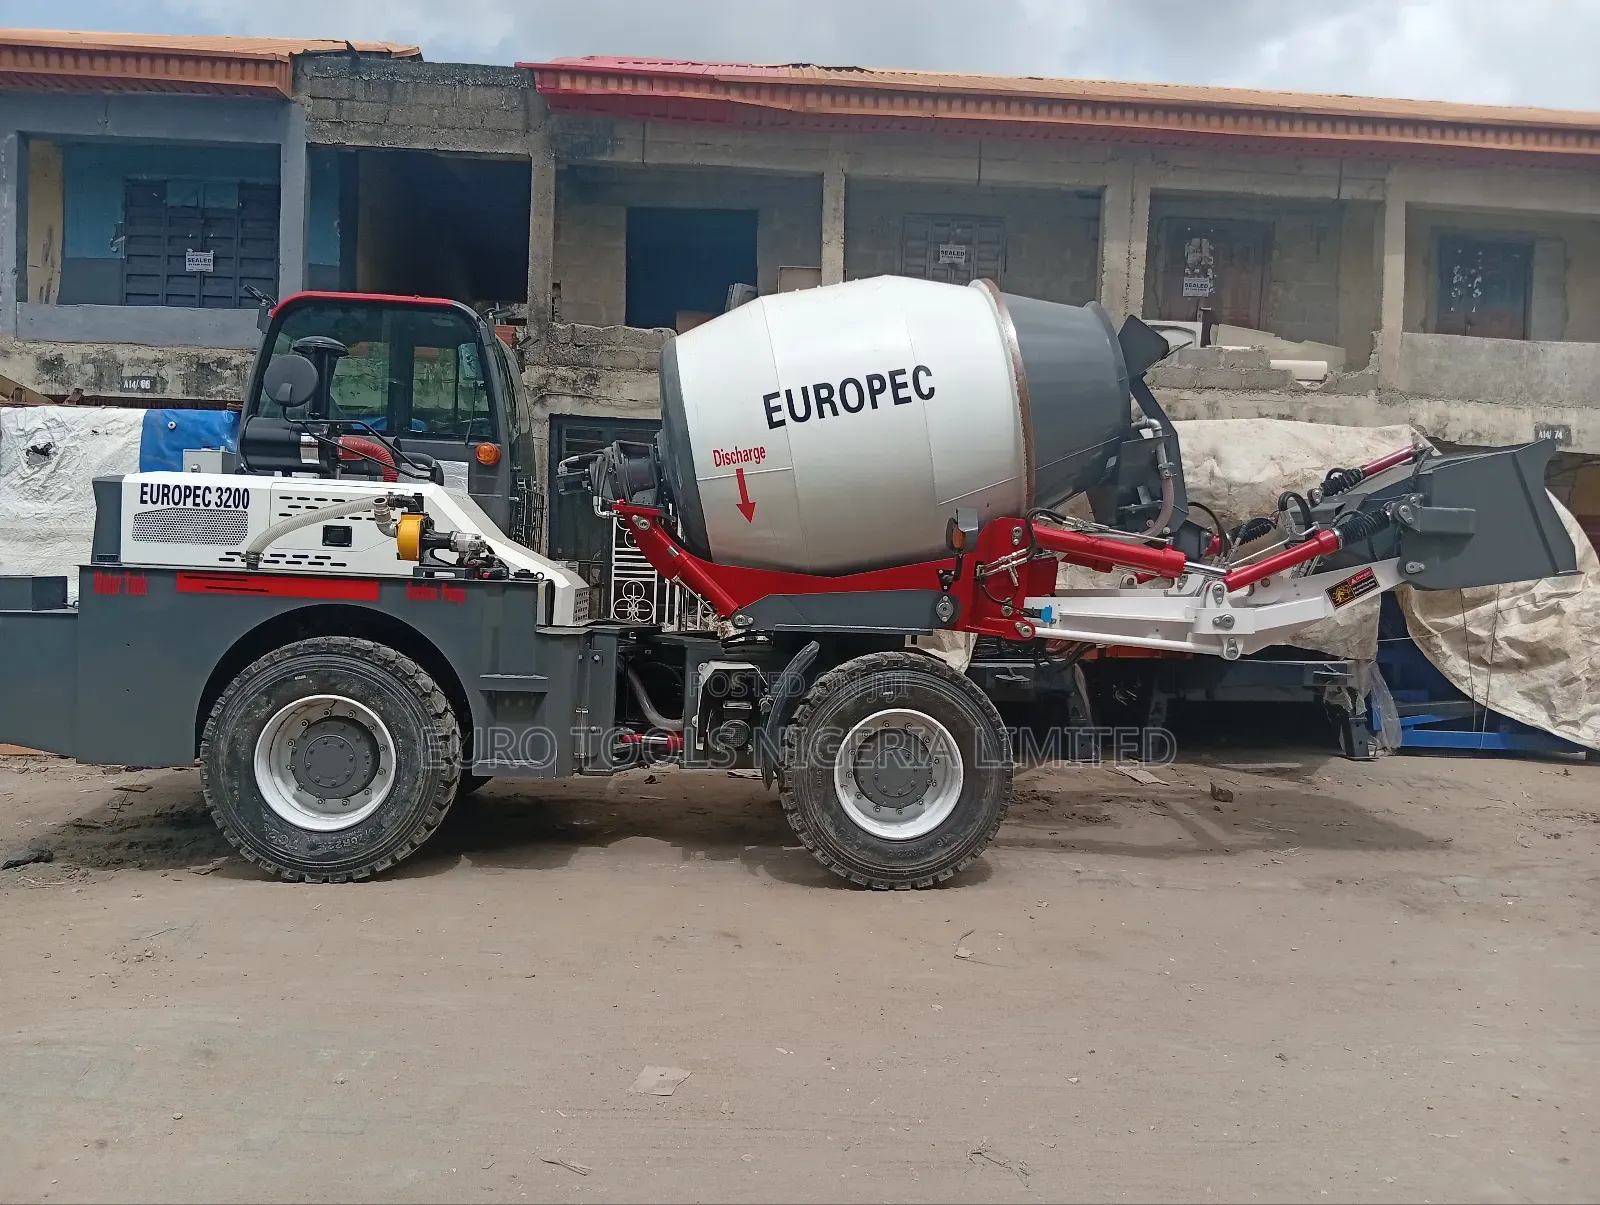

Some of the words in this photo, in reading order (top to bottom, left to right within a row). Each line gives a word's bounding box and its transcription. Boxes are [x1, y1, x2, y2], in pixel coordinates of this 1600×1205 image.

[762, 364, 936, 430] EUROPEC
[712, 445, 767, 468] Discharge
[139, 482, 212, 508] EUROPEC
[214, 486, 250, 510] 3200
